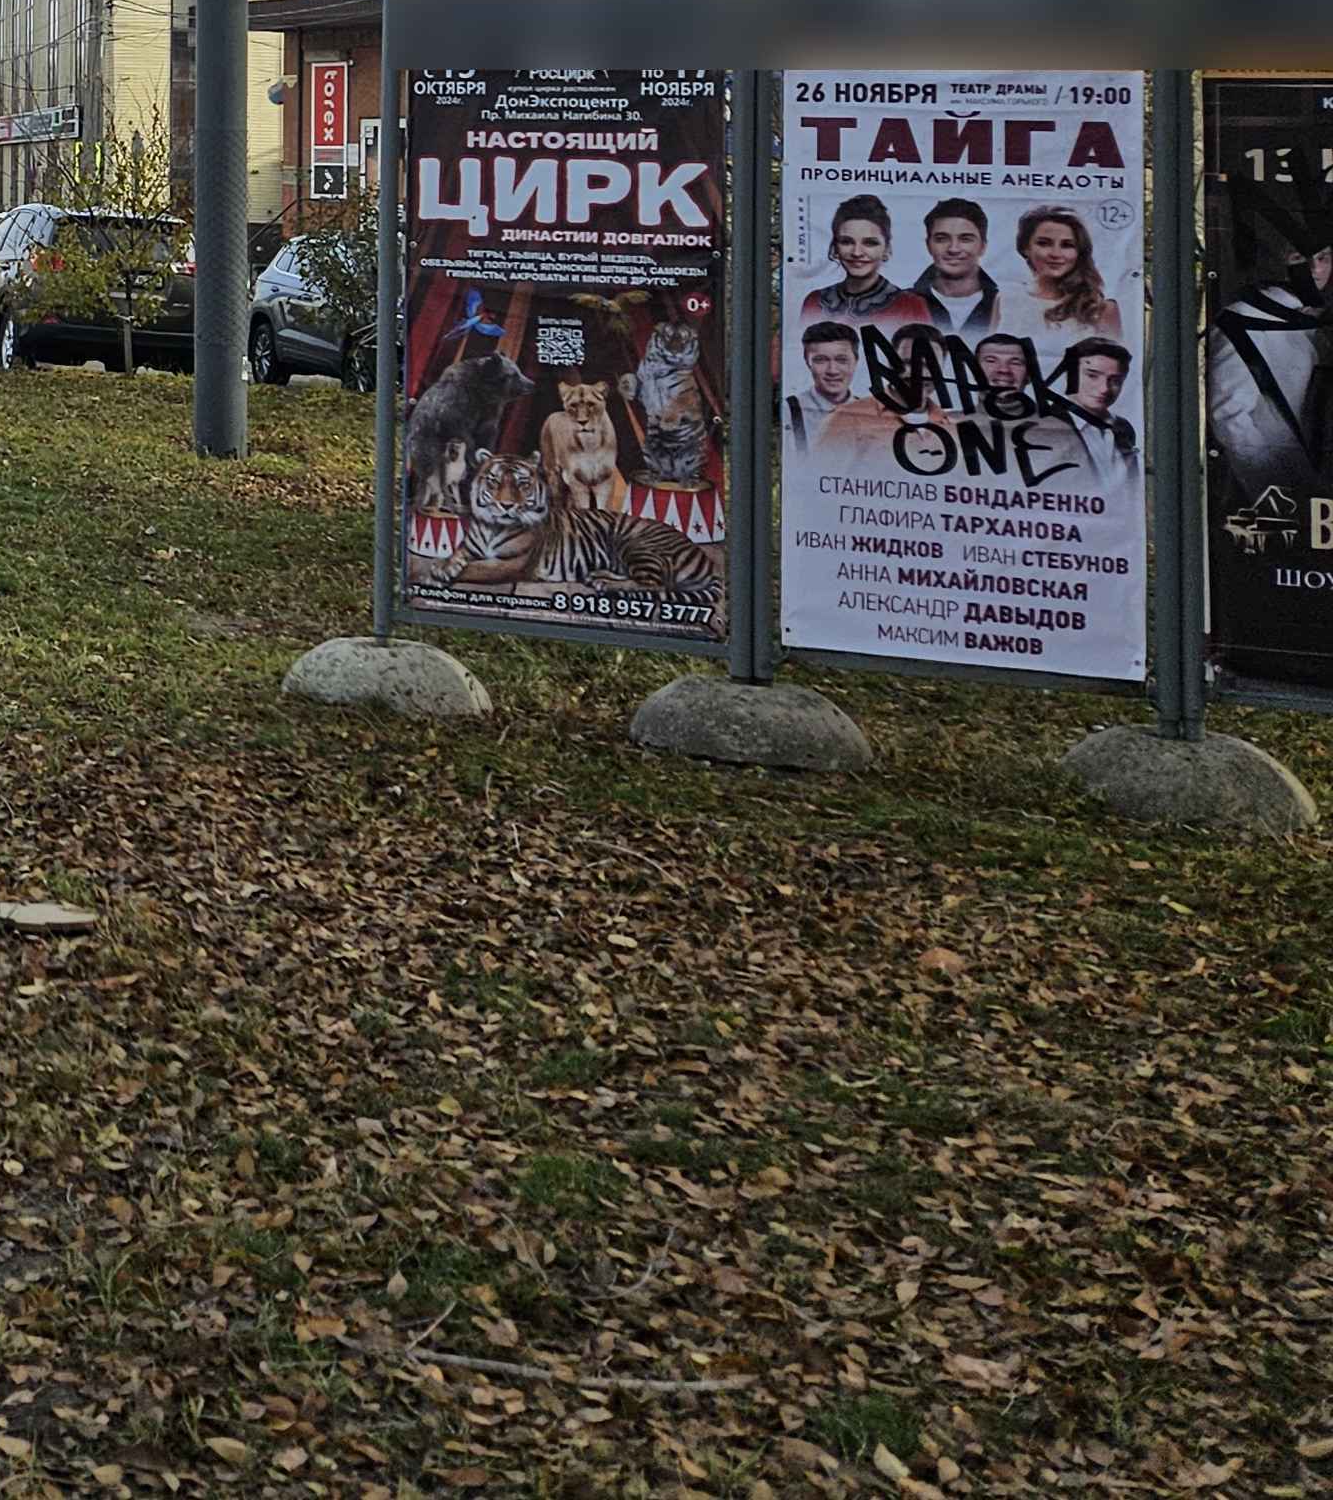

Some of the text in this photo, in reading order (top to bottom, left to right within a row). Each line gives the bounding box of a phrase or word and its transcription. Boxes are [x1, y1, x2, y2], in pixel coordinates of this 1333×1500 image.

[414, 81, 486, 95] ОКТЯБРЯ
[640, 82, 715, 97] НОЯБРЯ
[796, 83, 937, 104] 26 НОЯБРЯ
[950, 84, 1047, 96] ТЕАТР ДРАМЫ
[1070, 86, 1131, 105] 19:00
[323, 69, 338, 142] torex
[481, 109, 502, 121] Пр.
[504, 110, 560, 120] Михаила
[563, 110, 622, 121] Нагибина
[495, 94, 629, 111] ДонЭкспоцентр
[466, 128, 659, 153] НАСТОЯЩИЙ
[800, 110, 1126, 169] ТАЙГА
[801, 167, 1124, 190] ПРОВИНЦИАЛЬНЫЕ АНЕКДОТЫ
[418, 156, 710, 237] ЦИРК
[1100, 206, 1130, 223] 12+
[501, 229, 712, 247] ДИНАСТИИ ДОВГАЛЮК
[687, 298, 710, 312] 0+
[893, 420, 1079, 487] ONE
[819, 476, 1105, 514] СТАНИСЛАВ БОНДАРЕНКО
[839, 505, 1082, 543] ГЛАФИРА ТАРХАНОВА
[796, 531, 1129, 574] ИВАН ЖИДКОВ ИВАН СТЕБУНОВ
[837, 563, 1088, 600] АННА МИХАЙЛОВСКАЯ
[413, 585, 466, 600] Телефон
[470, 592, 493, 603] для
[554, 593, 567, 609] 8
[573, 596, 611, 614] 918
[617, 599, 653, 617] 957
[660, 604, 712, 623] 3777
[838, 591, 1086, 630] АЛЕКСАНДР ДАВЫДОВ
[878, 625, 1043, 655] МАКСИМ ВАЖОВ
